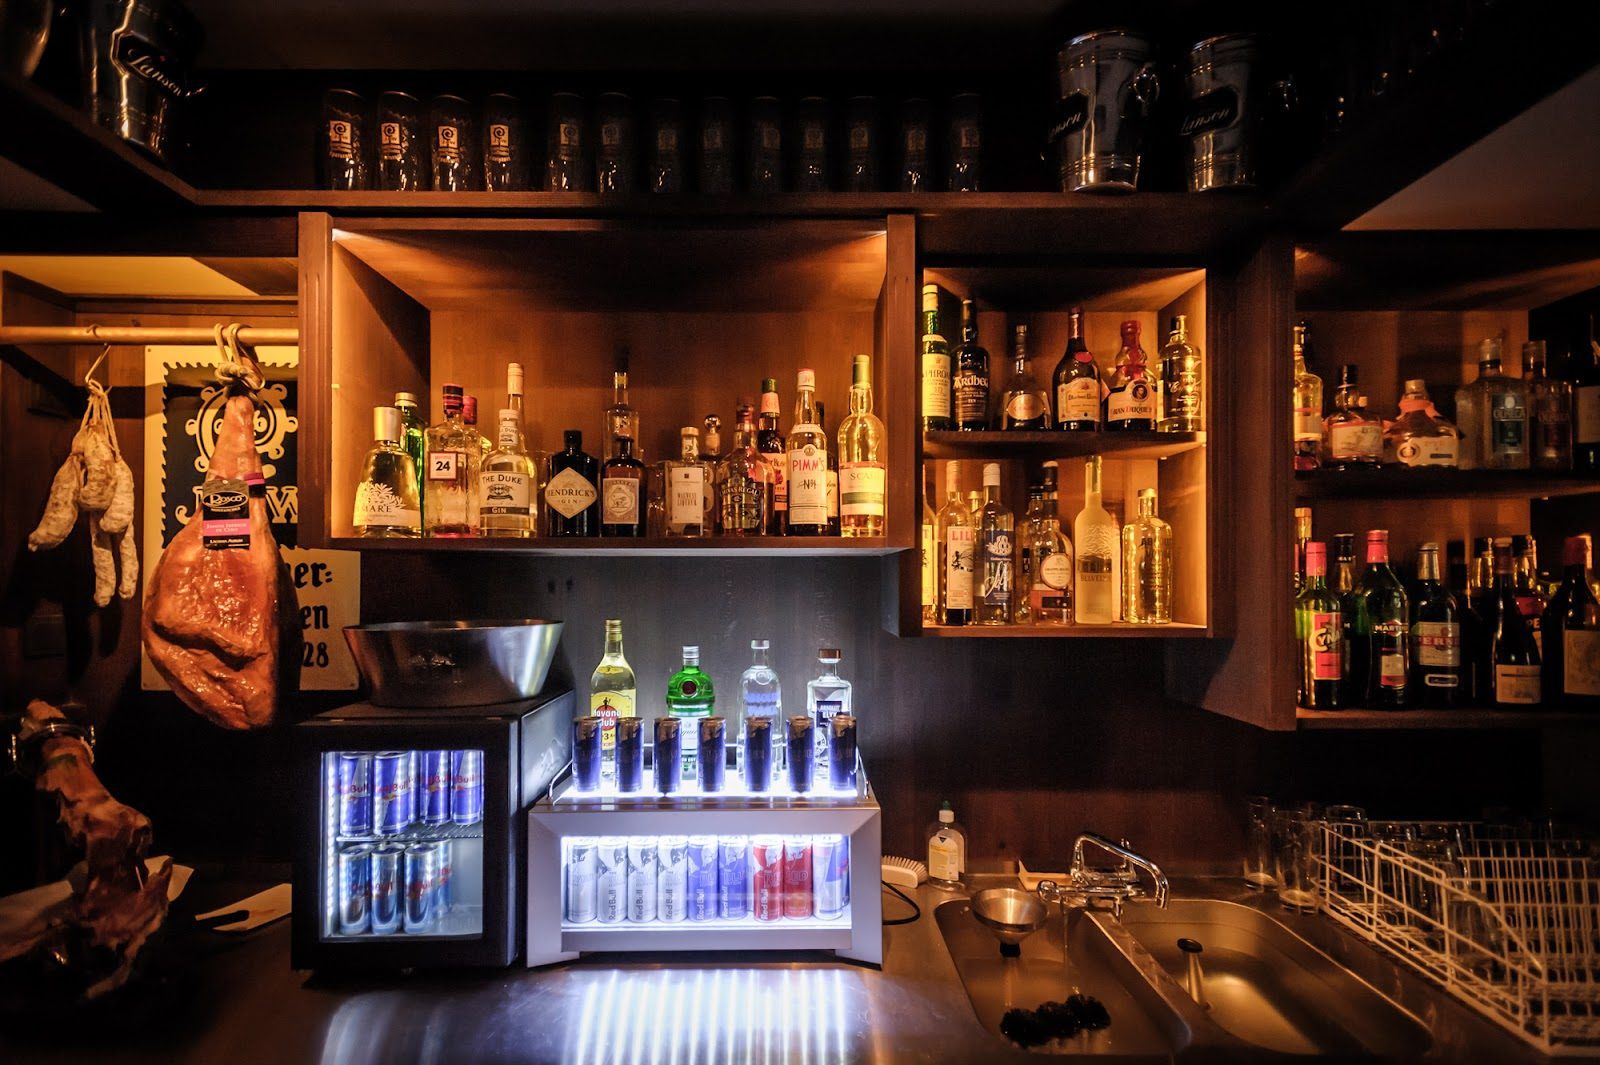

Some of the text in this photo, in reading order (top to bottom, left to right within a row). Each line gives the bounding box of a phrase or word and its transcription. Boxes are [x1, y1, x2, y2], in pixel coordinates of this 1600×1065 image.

[1048, 111, 1083, 143] anson
[435, 461, 451, 471] 24
[792, 458, 825, 473] PIMM'S
[482, 474, 522, 485] THE DUKE
[286, 563, 332, 588] er:
